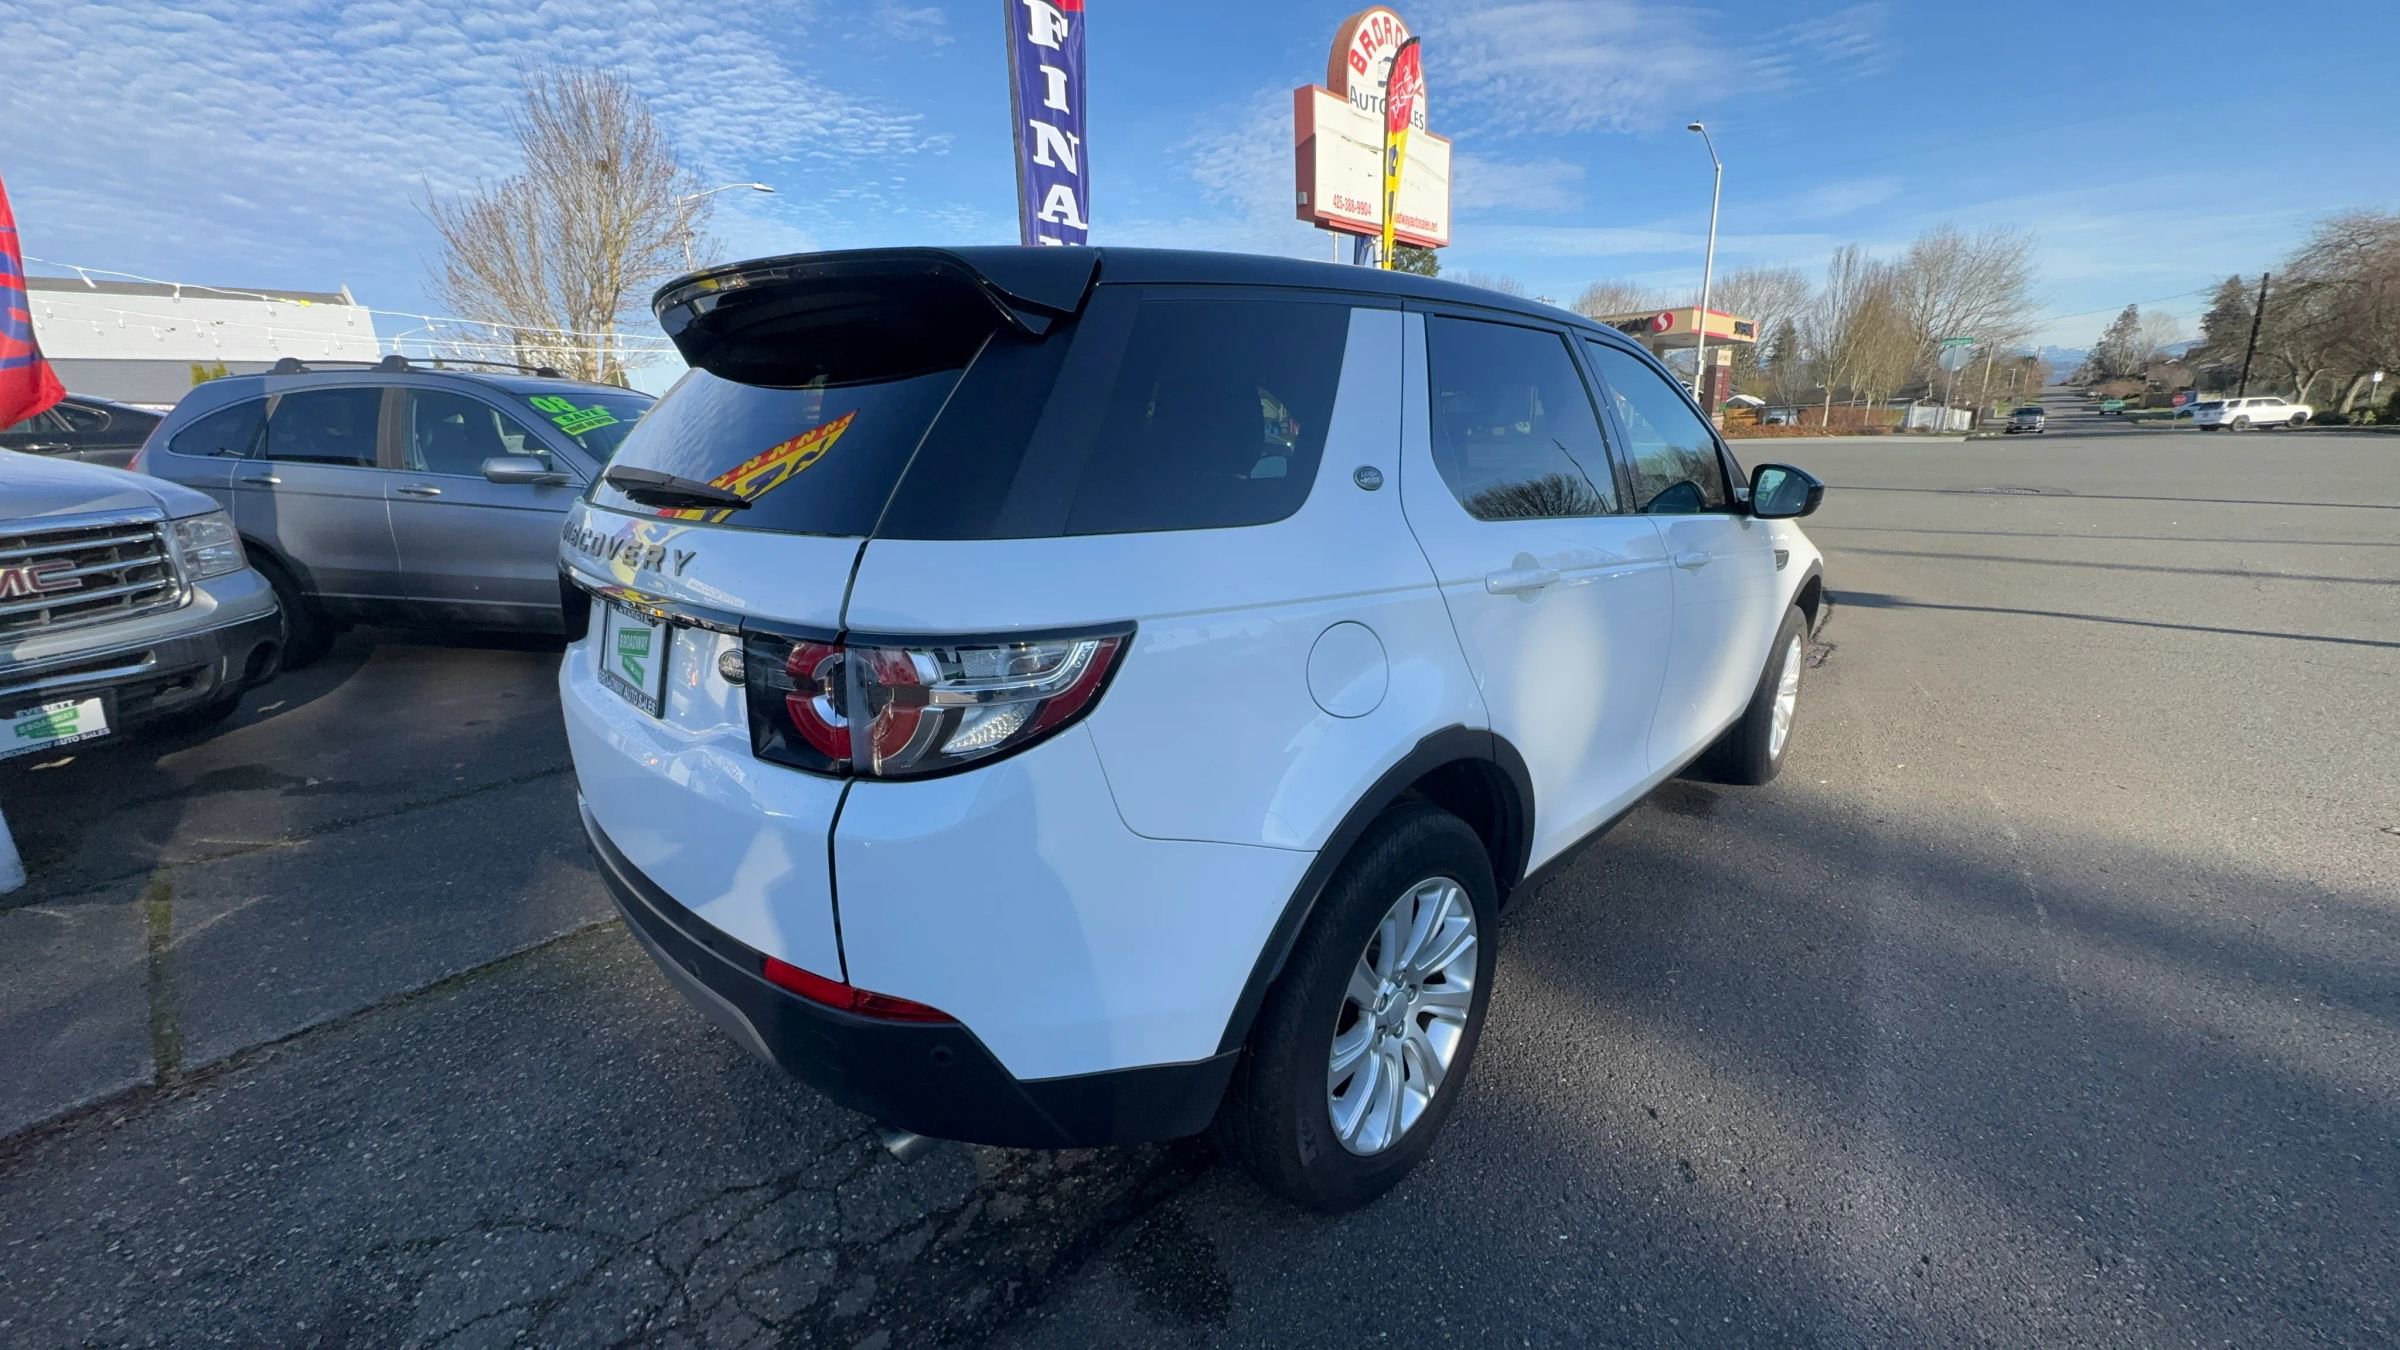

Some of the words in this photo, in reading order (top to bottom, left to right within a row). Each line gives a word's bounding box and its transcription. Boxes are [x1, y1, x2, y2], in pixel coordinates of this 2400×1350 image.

[1350, 16, 1424, 99] BROADY
[1022, 0, 1088, 247] FINA
[529, 396, 577, 413] 08
[562, 520, 696, 577] DISCOVERY
[0, 558, 83, 599] MC
[620, 634, 649, 651] BROADWAY
[623, 686, 639, 705] AUTO
[639, 694, 656, 716] SALES
[18, 710, 75, 734] BROADWAY
[54, 735, 80, 748] AUTO
[81, 727, 111, 741] SALES
